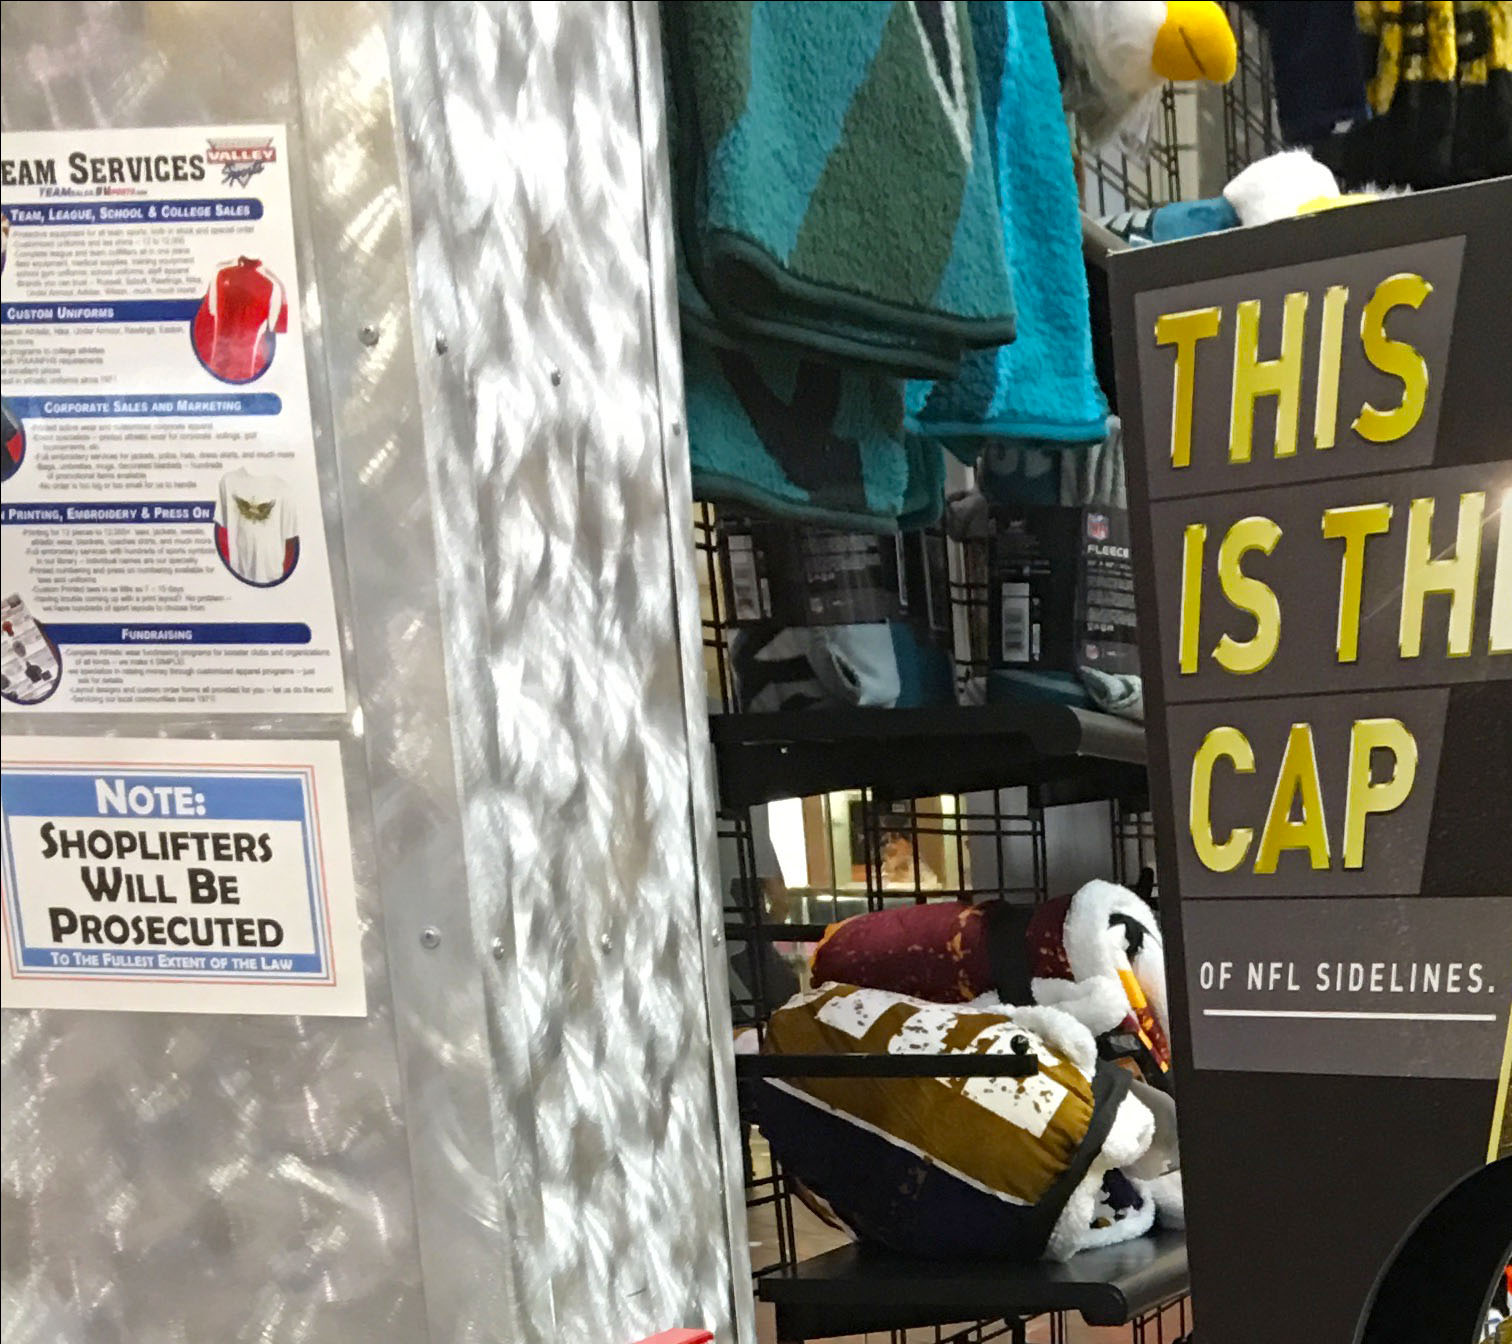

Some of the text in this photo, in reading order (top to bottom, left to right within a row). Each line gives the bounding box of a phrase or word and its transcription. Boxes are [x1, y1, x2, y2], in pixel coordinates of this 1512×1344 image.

[68, 151, 206, 184] SERVICES
[208, 149, 274, 161] VALLEY
[11, 202, 250, 222] TEAM, LEAGUE, SCHOOL & COLLEGE SALES
[7, 306, 114, 320] CUSTOM UNIFORMS
[1154, 272, 1434, 468] THIS
[44, 399, 242, 414] CORPORATE SALES AND MARKETING
[8, 506, 64, 524] PRINTING,
[66, 506, 138, 521] EMBROIDERY
[141, 506, 150, 520] &
[154, 506, 189, 520] PRESS
[193, 506, 210, 520] ON
[1178, 516, 1283, 675] IS
[121, 628, 193, 641] FUNDRAISING
[95, 778, 206, 816] NOTE:
[1189, 717, 1419, 875] CAP
[40, 821, 273, 863] SHOPLIFTERS
[81, 866, 240, 905] WILL BE
[48, 907, 284, 948] PROSECUTED
[51, 951, 293, 971] TO THE FULLEST EXTENT OF THE LAW
[1200, 961, 1496, 994] OF NFL SIDELINES.
